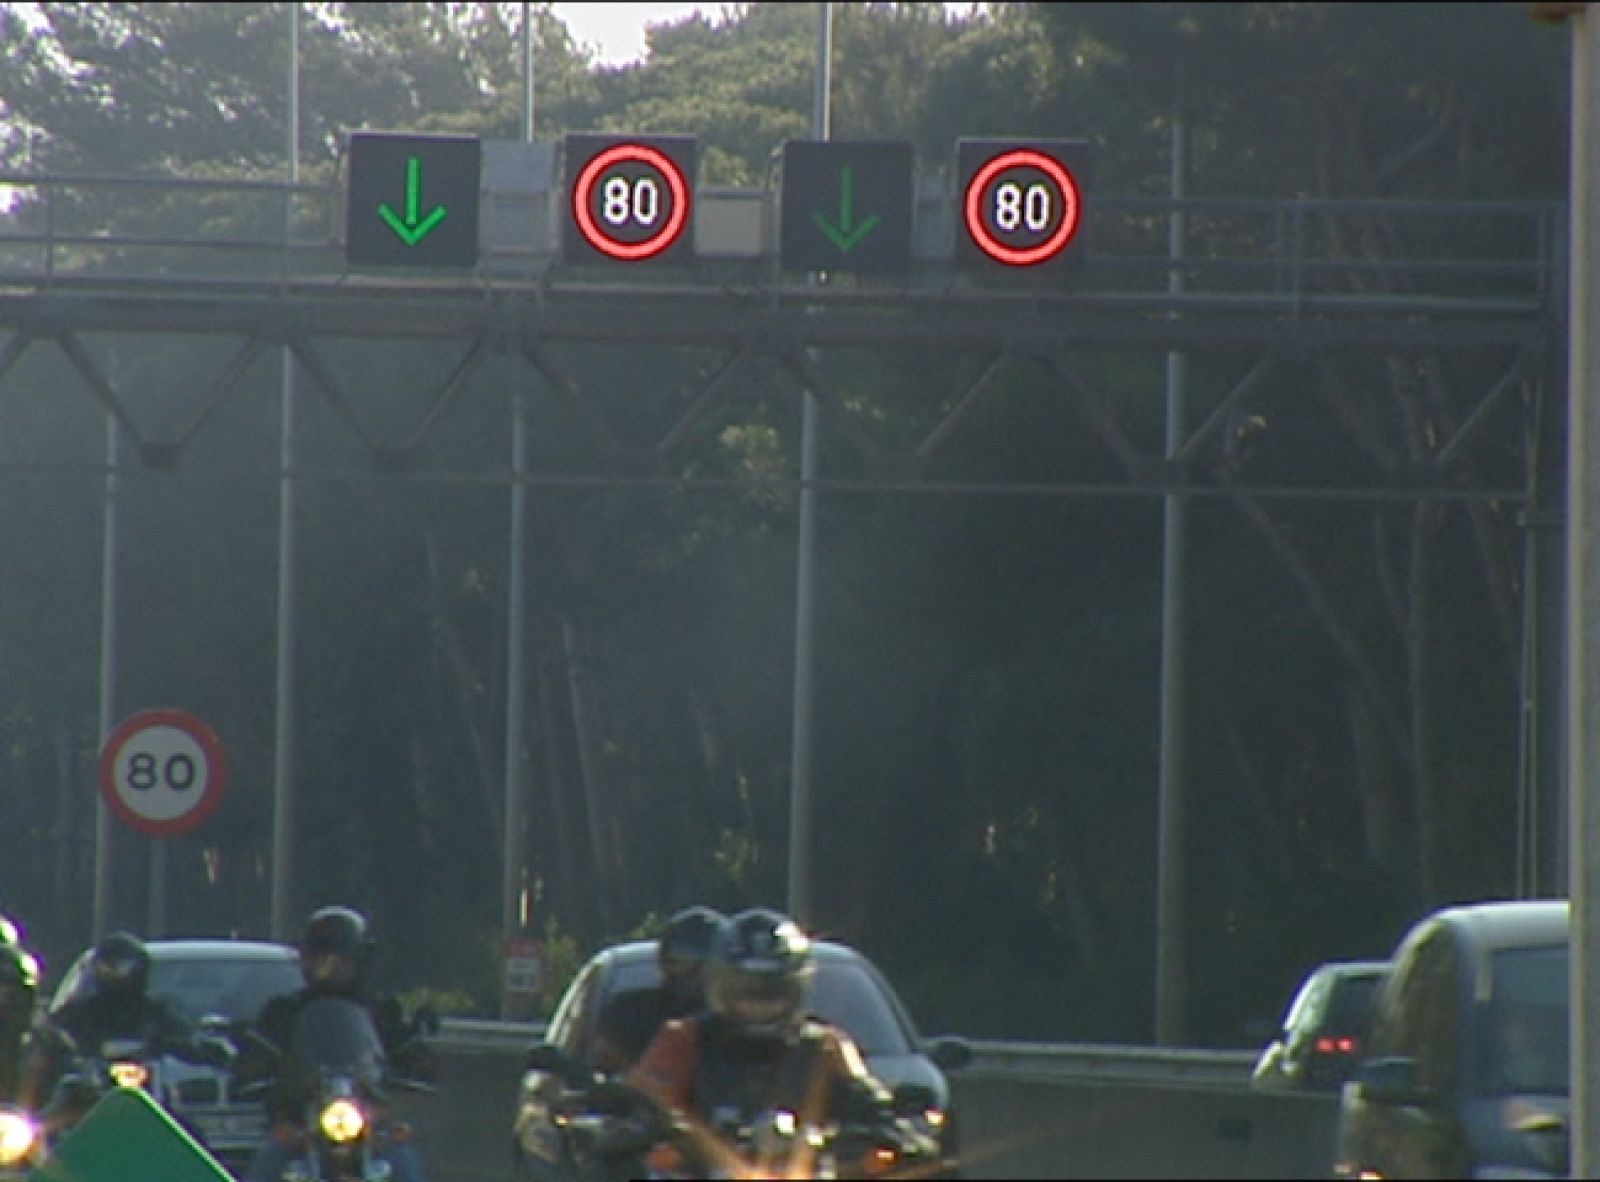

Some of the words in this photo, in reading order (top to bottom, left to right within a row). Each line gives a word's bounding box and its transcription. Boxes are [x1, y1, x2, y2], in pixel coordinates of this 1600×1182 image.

[602, 177, 659, 225] 80
[995, 183, 1052, 231] 80
[127, 752, 195, 791] 80
